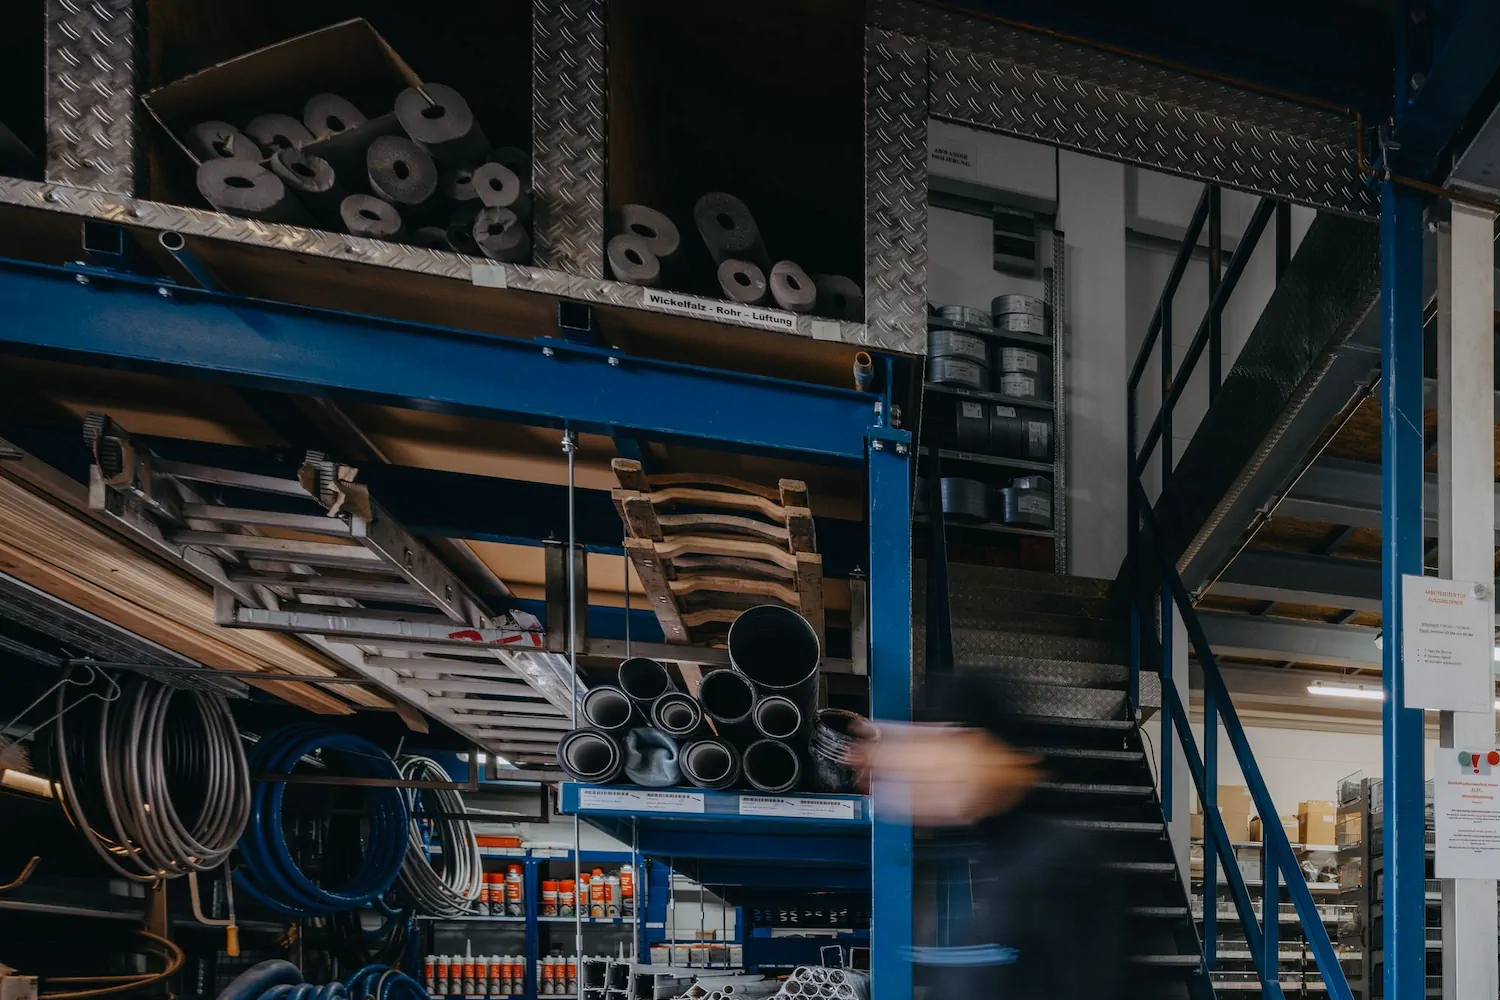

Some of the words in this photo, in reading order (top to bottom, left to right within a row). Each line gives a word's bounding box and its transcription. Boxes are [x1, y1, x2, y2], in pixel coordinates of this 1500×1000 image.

[649, 294, 707, 312] Wickelfalz
[716, 306, 742, 318] Rohr
[753, 311, 793, 328] Lüftung
